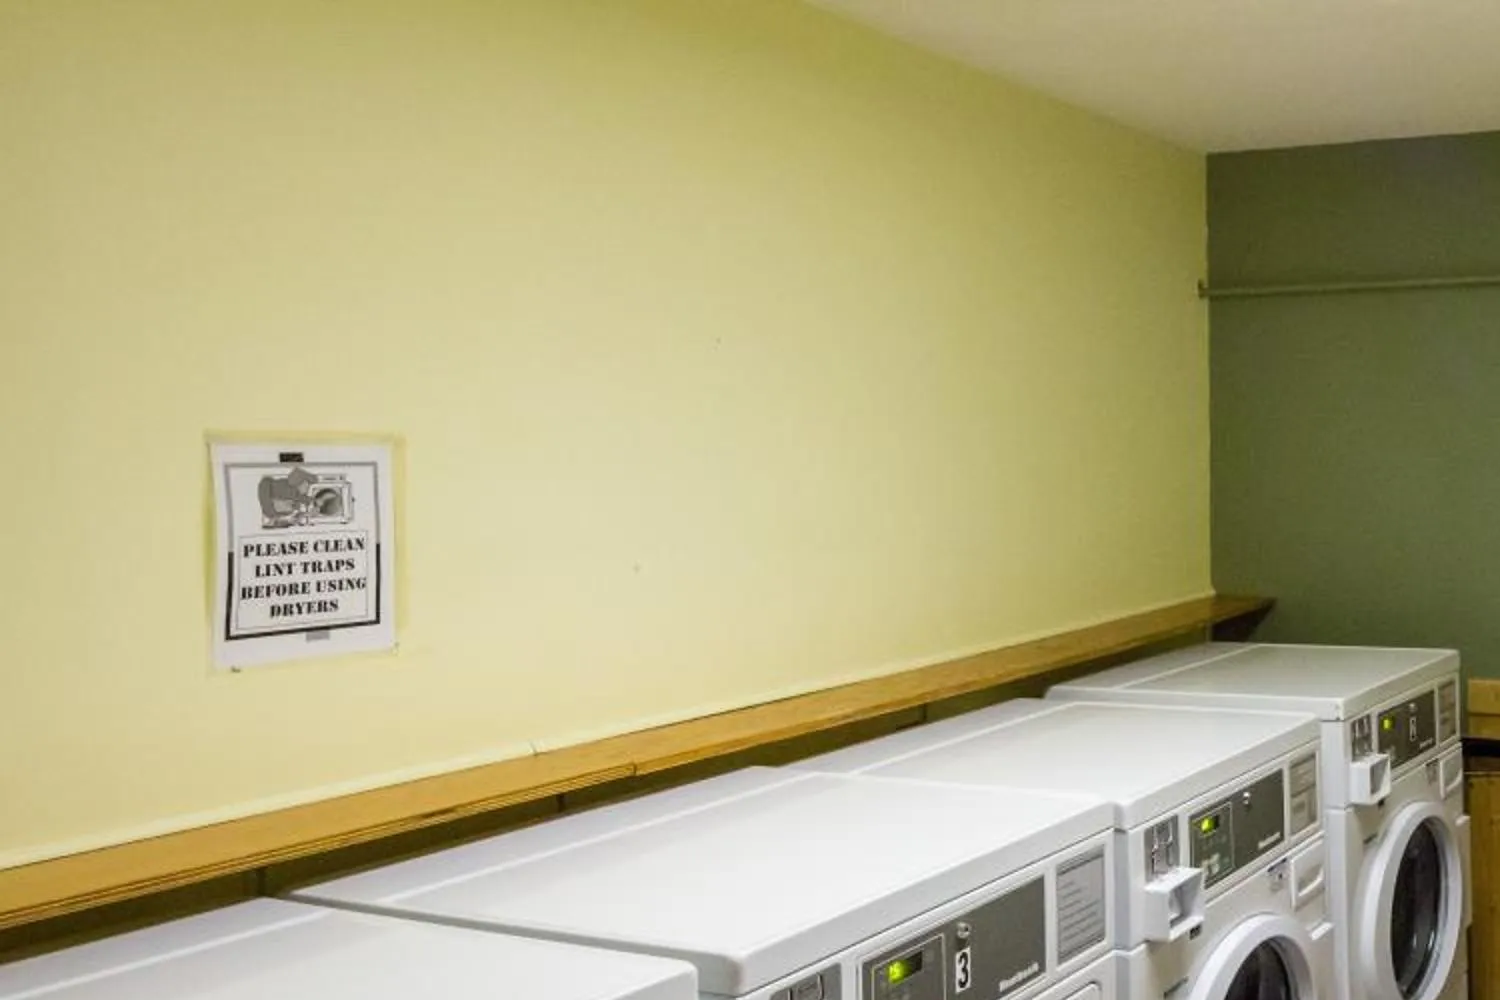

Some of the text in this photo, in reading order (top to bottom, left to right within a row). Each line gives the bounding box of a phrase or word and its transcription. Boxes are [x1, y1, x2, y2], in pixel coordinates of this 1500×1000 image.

[243, 537, 365, 557] PLEASE CLEAN
[255, 559, 355, 578] LINT TRAPS
[241, 576, 367, 600] BEFORE USING
[270, 599, 339, 618] DRYERS
[956, 951, 969, 989] 3
